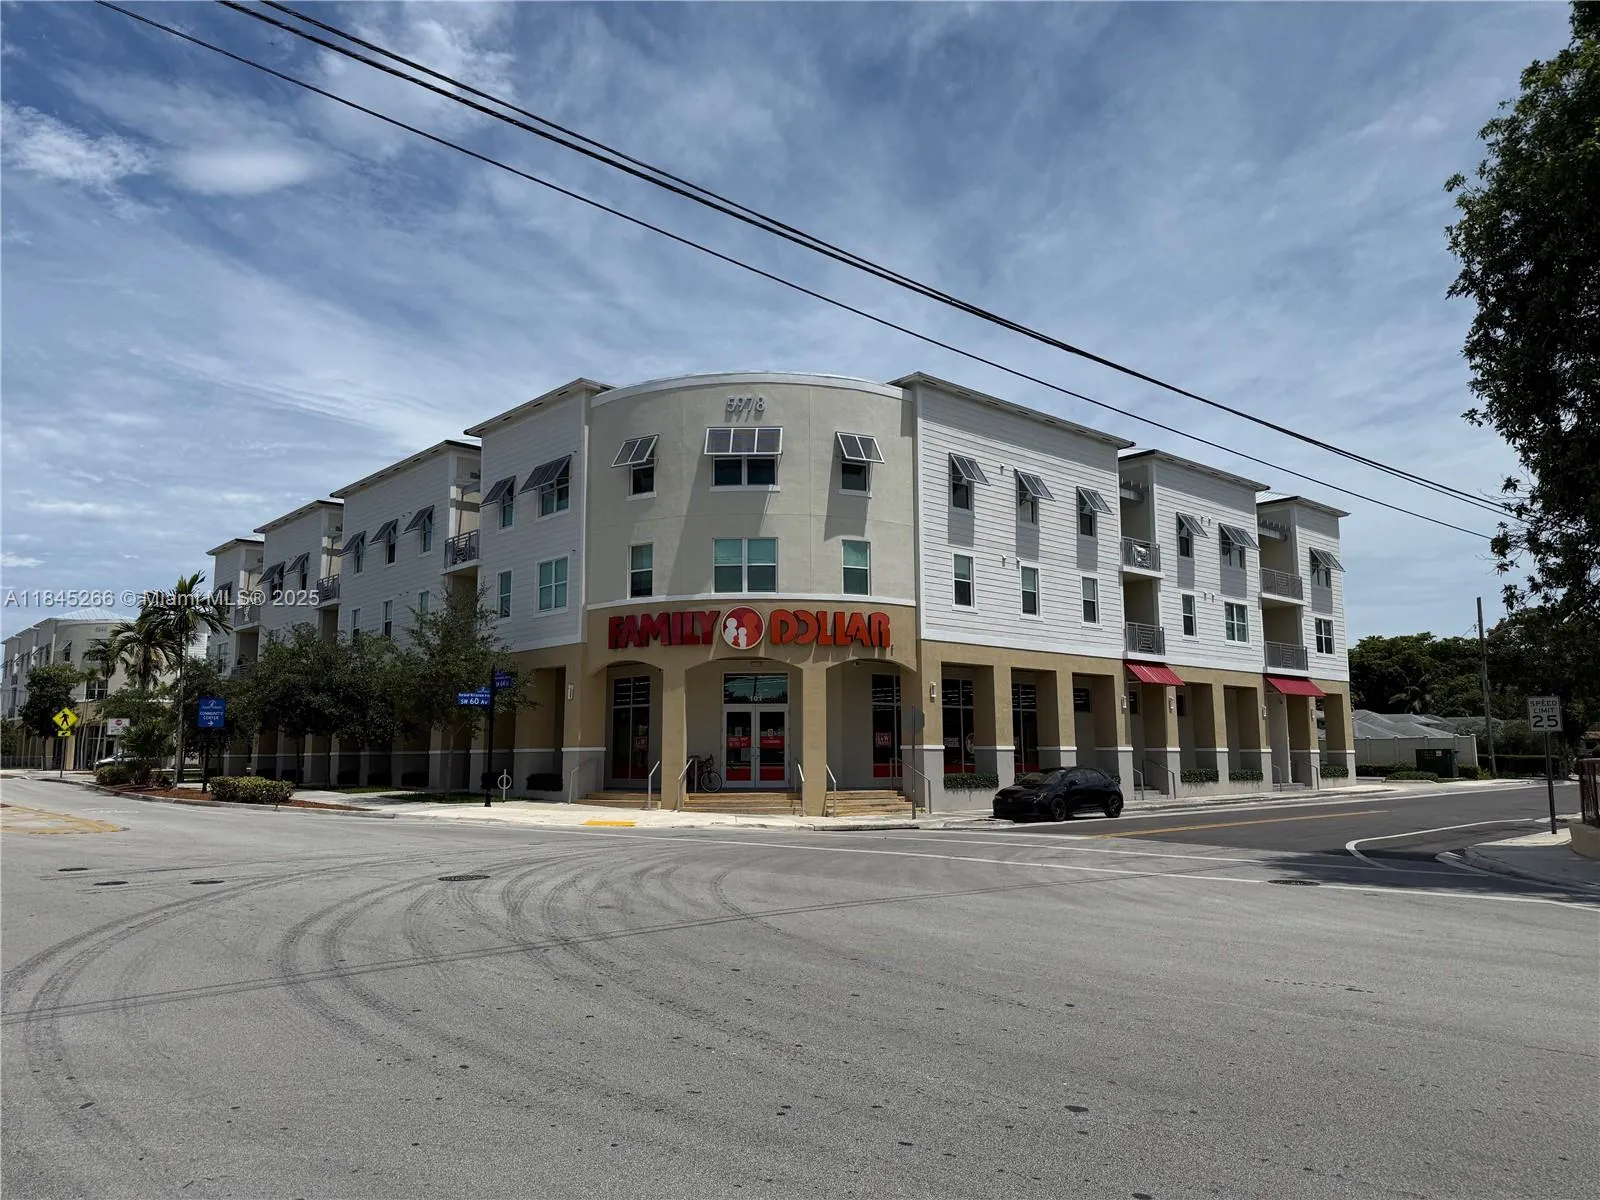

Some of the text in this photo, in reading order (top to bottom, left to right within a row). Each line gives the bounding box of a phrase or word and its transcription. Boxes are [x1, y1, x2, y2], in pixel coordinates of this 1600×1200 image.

[727, 395, 765, 412] 5978
[608, 609, 891, 650] FAMILY DOLLAR
[469, 697, 479, 705] 60
[1532, 715, 1559, 728] 25
